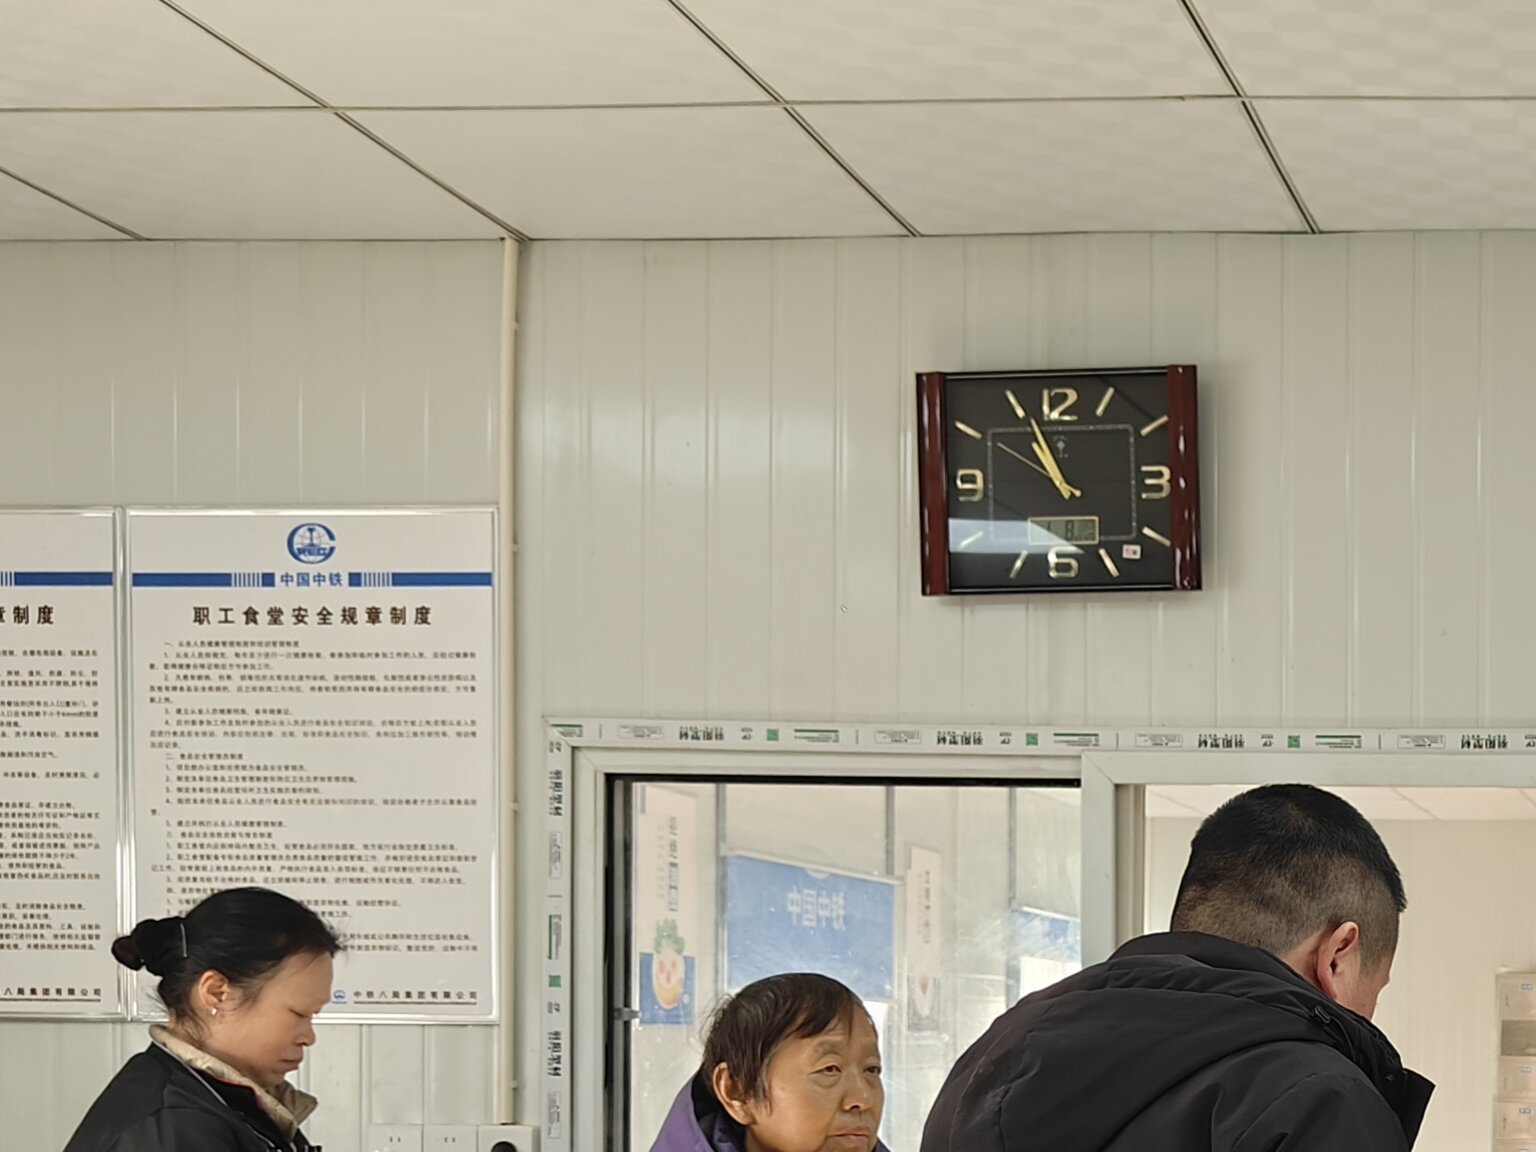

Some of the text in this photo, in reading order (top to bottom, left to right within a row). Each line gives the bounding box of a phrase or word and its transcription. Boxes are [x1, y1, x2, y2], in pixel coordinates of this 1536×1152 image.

[1042, 387, 1078, 420] 12
[956, 469, 984, 502] 9
[1140, 465, 1171, 499] 3
[1048, 546, 1079, 578] 6
[280, 572, 343, 587] 中国中铁
[193, 606, 432, 625] 职工食堂安全规章制度
